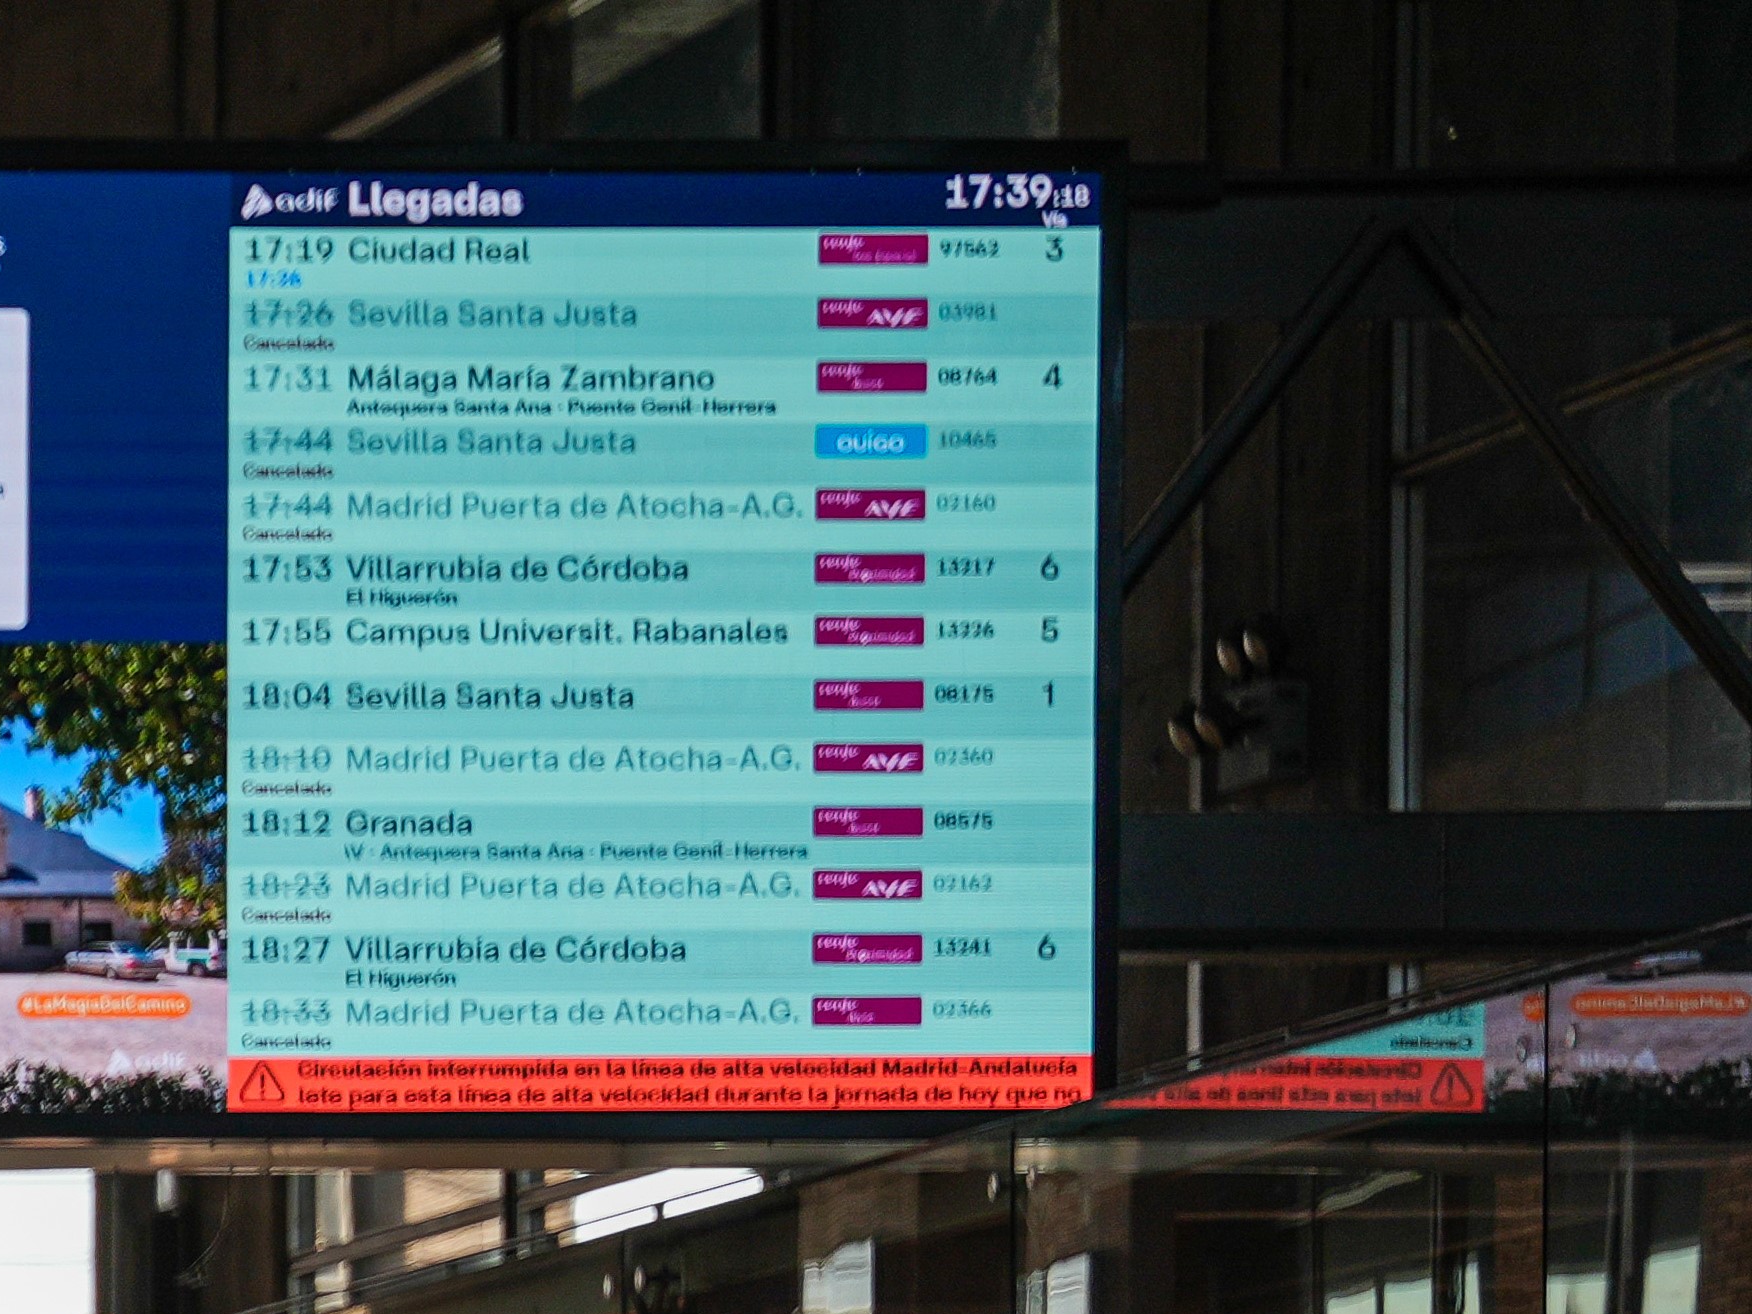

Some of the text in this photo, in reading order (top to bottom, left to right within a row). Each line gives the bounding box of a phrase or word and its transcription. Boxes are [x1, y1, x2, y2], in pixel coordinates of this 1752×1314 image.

[275, 187, 341, 213] adif
[348, 180, 525, 224] Llegadas
[247, 234, 1063, 263] 17:19 Ciudad Real 3
[246, 364, 1062, 397] 17:31 Málaga María Zambrano 4
[243, 554, 1060, 582] 17:53 Villarrubia de Córdoba 6
[243, 618, 1060, 651] 17:55 Campus Universit. Rabanales 5
[243, 809, 473, 836] 18:12 Granada
